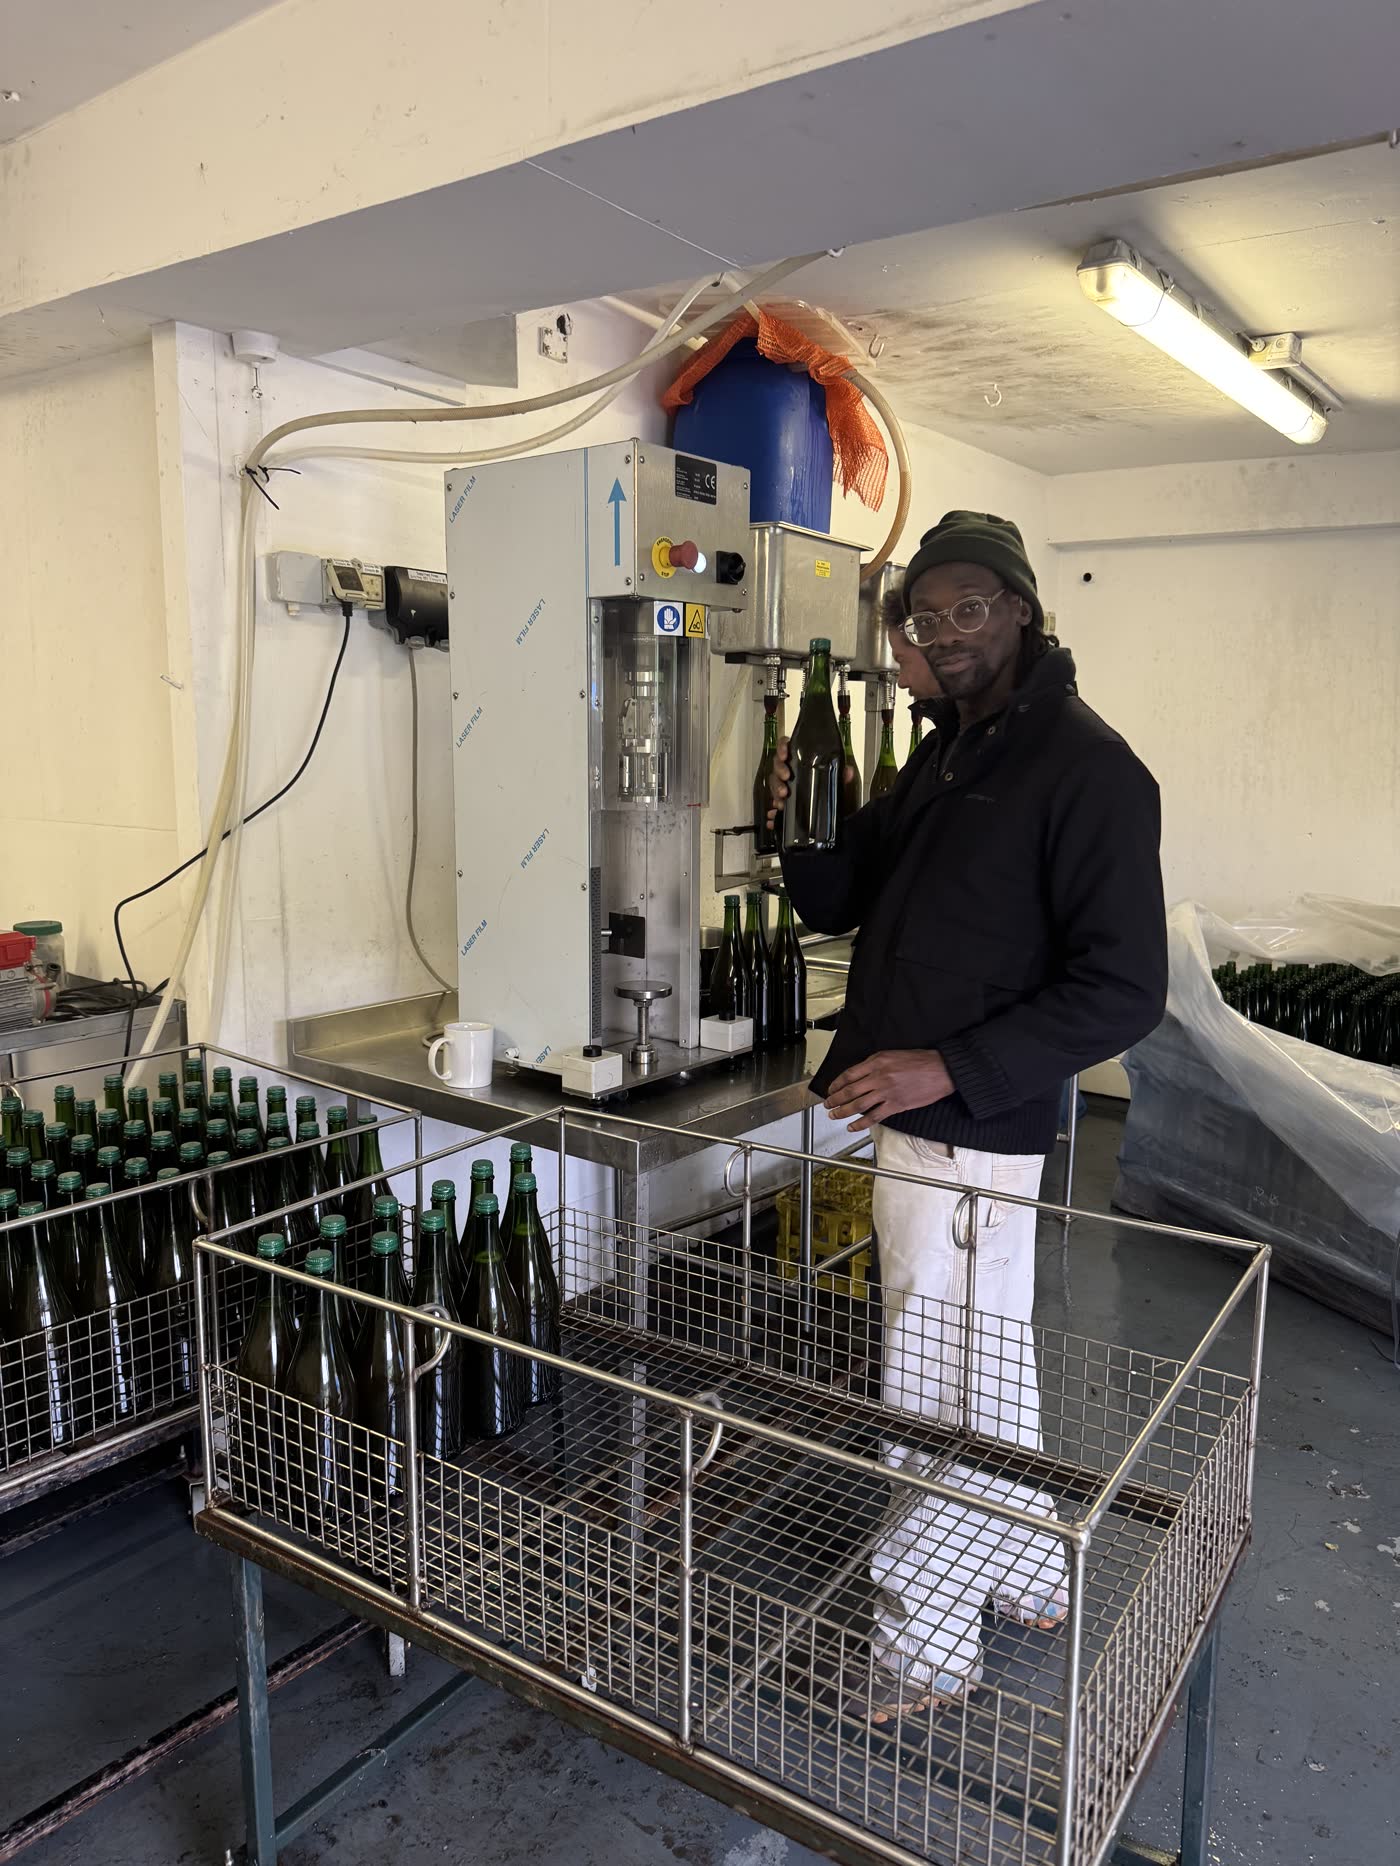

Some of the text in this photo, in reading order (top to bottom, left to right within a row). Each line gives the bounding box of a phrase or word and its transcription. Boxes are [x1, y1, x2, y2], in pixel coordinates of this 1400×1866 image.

[449, 475, 476, 523] LASER FILM
[705, 474, 716, 490] CE
[516, 598, 546, 645] LASER FILM
[456, 706, 483, 748] LASER FILM
[520, 828, 550, 869] LASER FILM
[461, 919, 488, 956] LASER FILM
[535, 1045, 552, 1064] LASE
